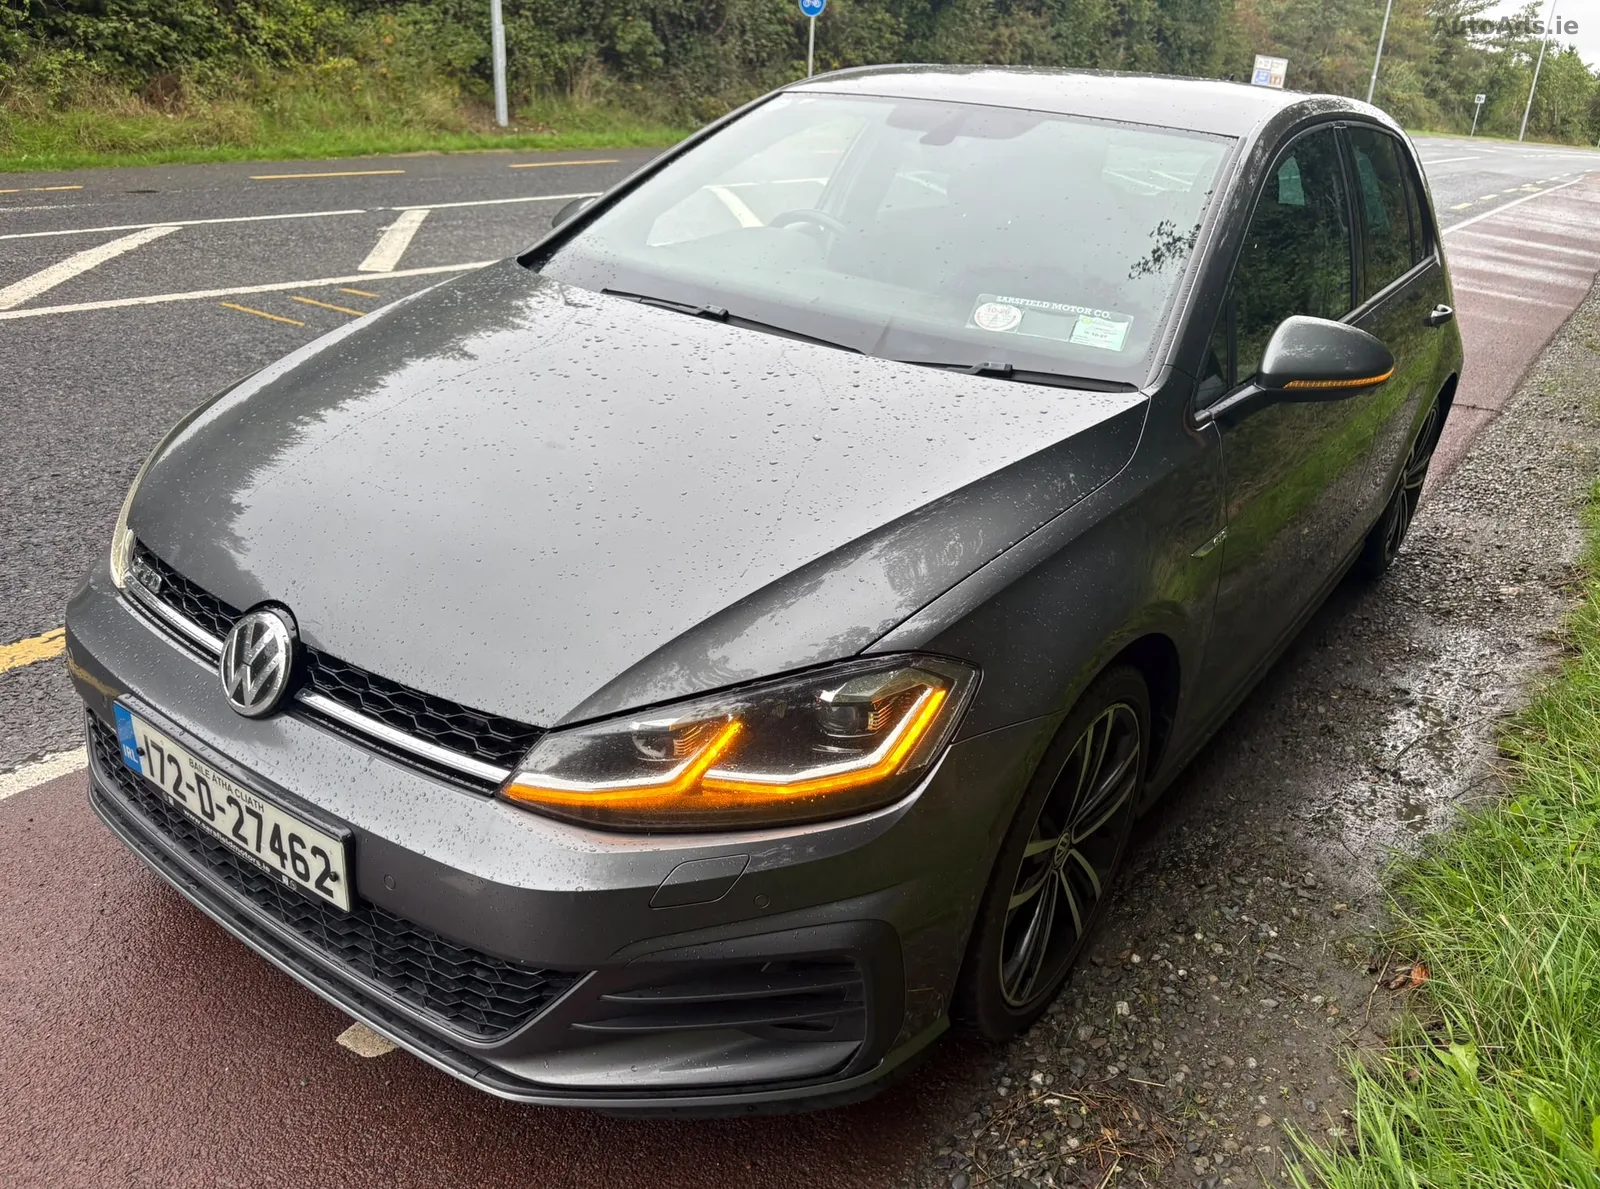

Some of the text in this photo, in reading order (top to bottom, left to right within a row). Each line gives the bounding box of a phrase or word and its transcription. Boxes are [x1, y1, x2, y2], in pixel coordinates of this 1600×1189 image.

[996, 296, 1111, 320] SARSFIELD MOTOR CO.
[122, 743, 139, 764] IRL
[188, 757, 211, 780] BAILE
[234, 788, 265, 814] CLIATH
[143, 734, 335, 899] 172-D-27462
[183, 809, 271, 873] www.sarsfieldmotors.ie
